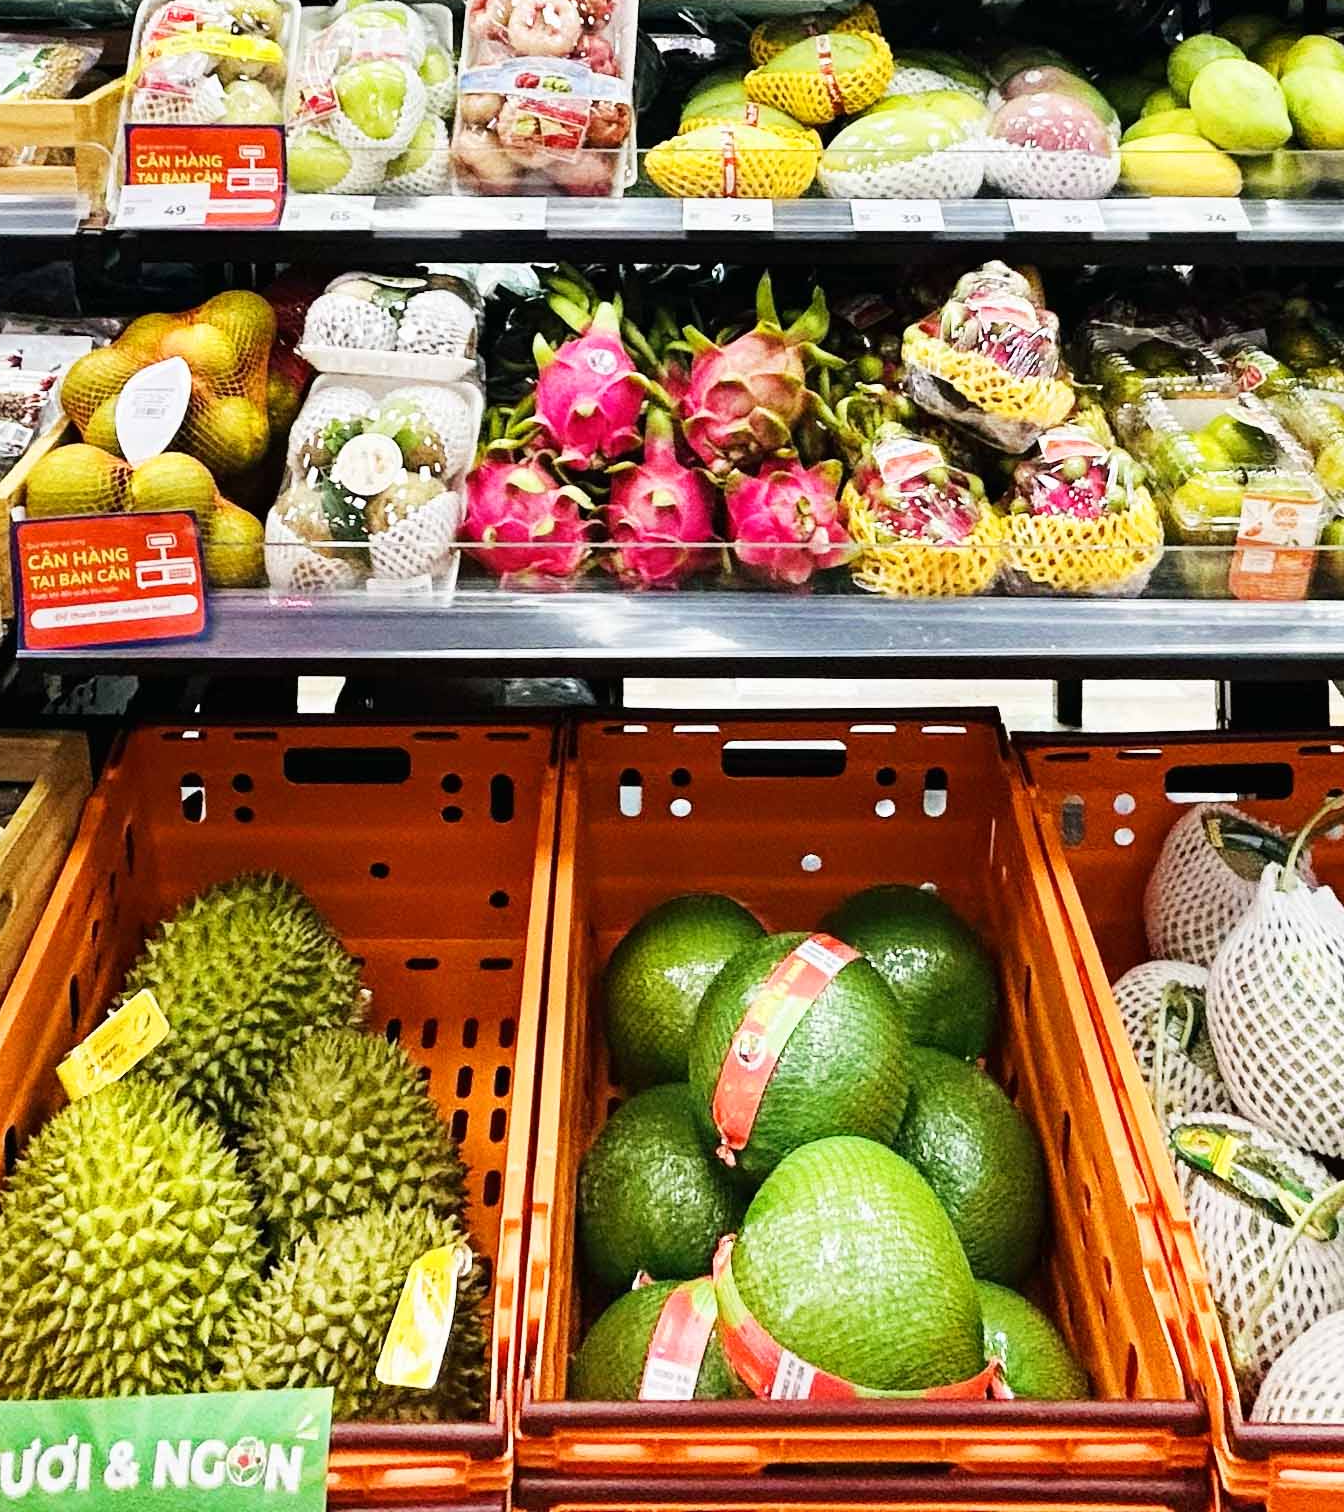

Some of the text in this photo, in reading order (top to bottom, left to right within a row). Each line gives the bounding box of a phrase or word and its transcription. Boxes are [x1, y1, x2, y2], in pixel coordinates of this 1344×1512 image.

[136, 151, 223, 168] CÂN HÀNG
[162, 170, 191, 184] BÀN
[163, 205, 187, 216] 49
[28, 546, 129, 570] CÂN HÀNG
[59, 569, 93, 587] BÀN
[97, 565, 131, 583] CÂN
[103, 1438, 140, 1491] &
